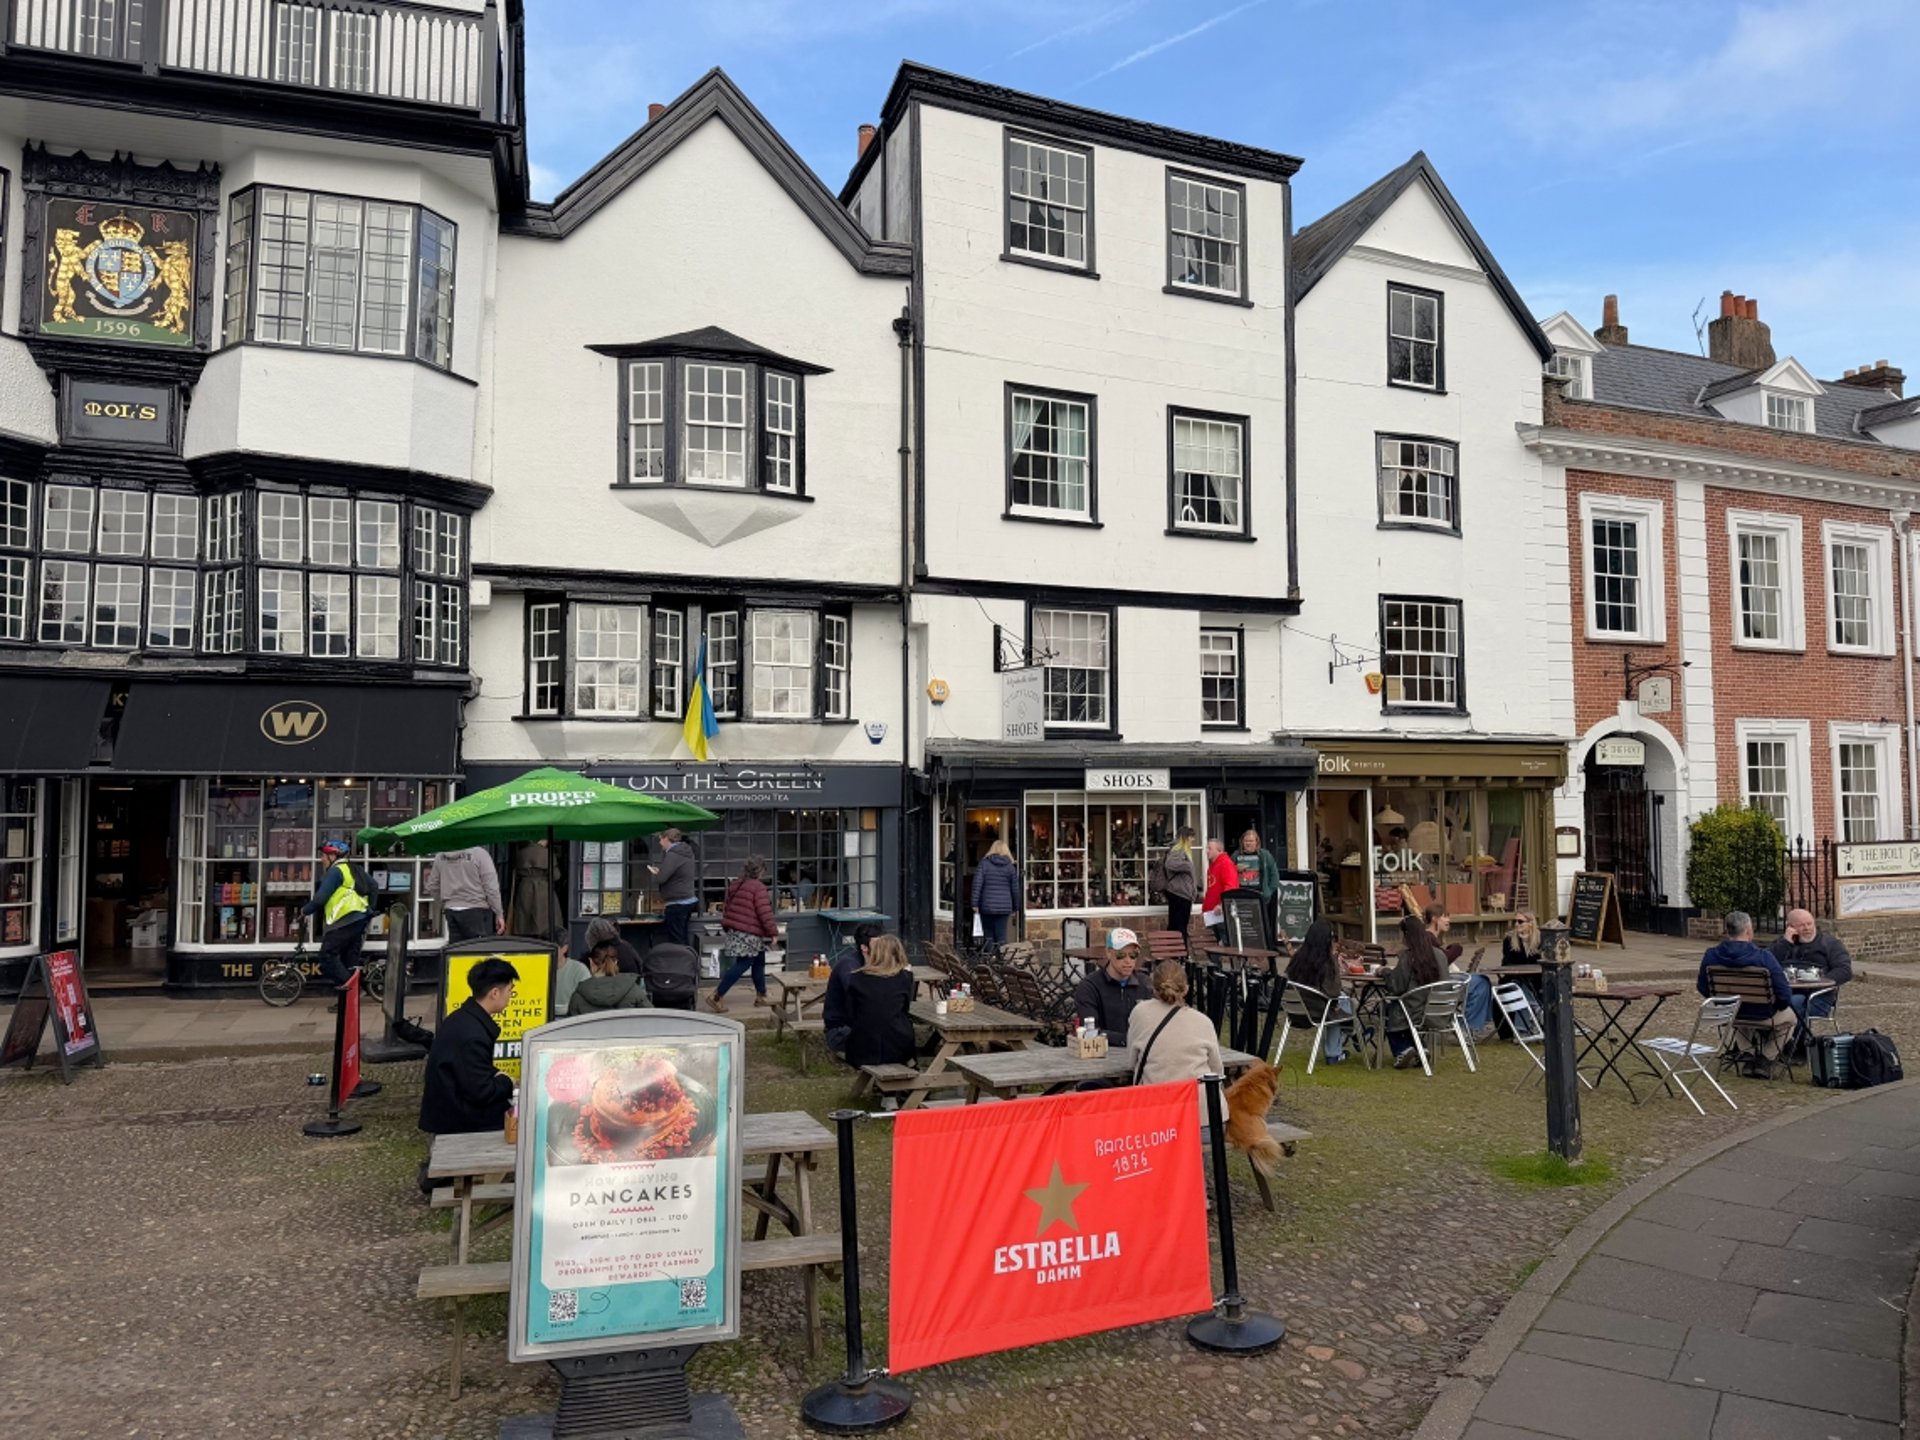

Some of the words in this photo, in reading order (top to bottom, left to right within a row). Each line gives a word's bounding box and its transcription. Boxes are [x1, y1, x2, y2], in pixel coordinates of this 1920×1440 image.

[94, 320, 141, 336] 1596
[84, 402, 156, 420] MOL'S
[270, 711, 320, 737] W
[1006, 722, 1039, 737] SHOES
[1318, 754, 1351, 772] folk
[682, 773, 729, 790] THE
[737, 770, 822, 790] GREEN
[1103, 774, 1153, 787] SHOES
[505, 791, 599, 808] PROPER
[1374, 845, 1424, 873] folk
[1859, 848, 1878, 861] THE
[1880, 847, 1904, 860] HOLT
[221, 963, 253, 977] THE
[512, 1007, 542, 1018] THE
[1094, 1128, 1178, 1156] BARCELONA
[1112, 1151, 1148, 1174] 1876
[570, 1184, 693, 1207] PANCAKES
[600, 1218, 626, 1227] DAILY
[993, 1231, 1121, 1274] ESTRELLA
[1036, 1265, 1082, 1285] DAMM
